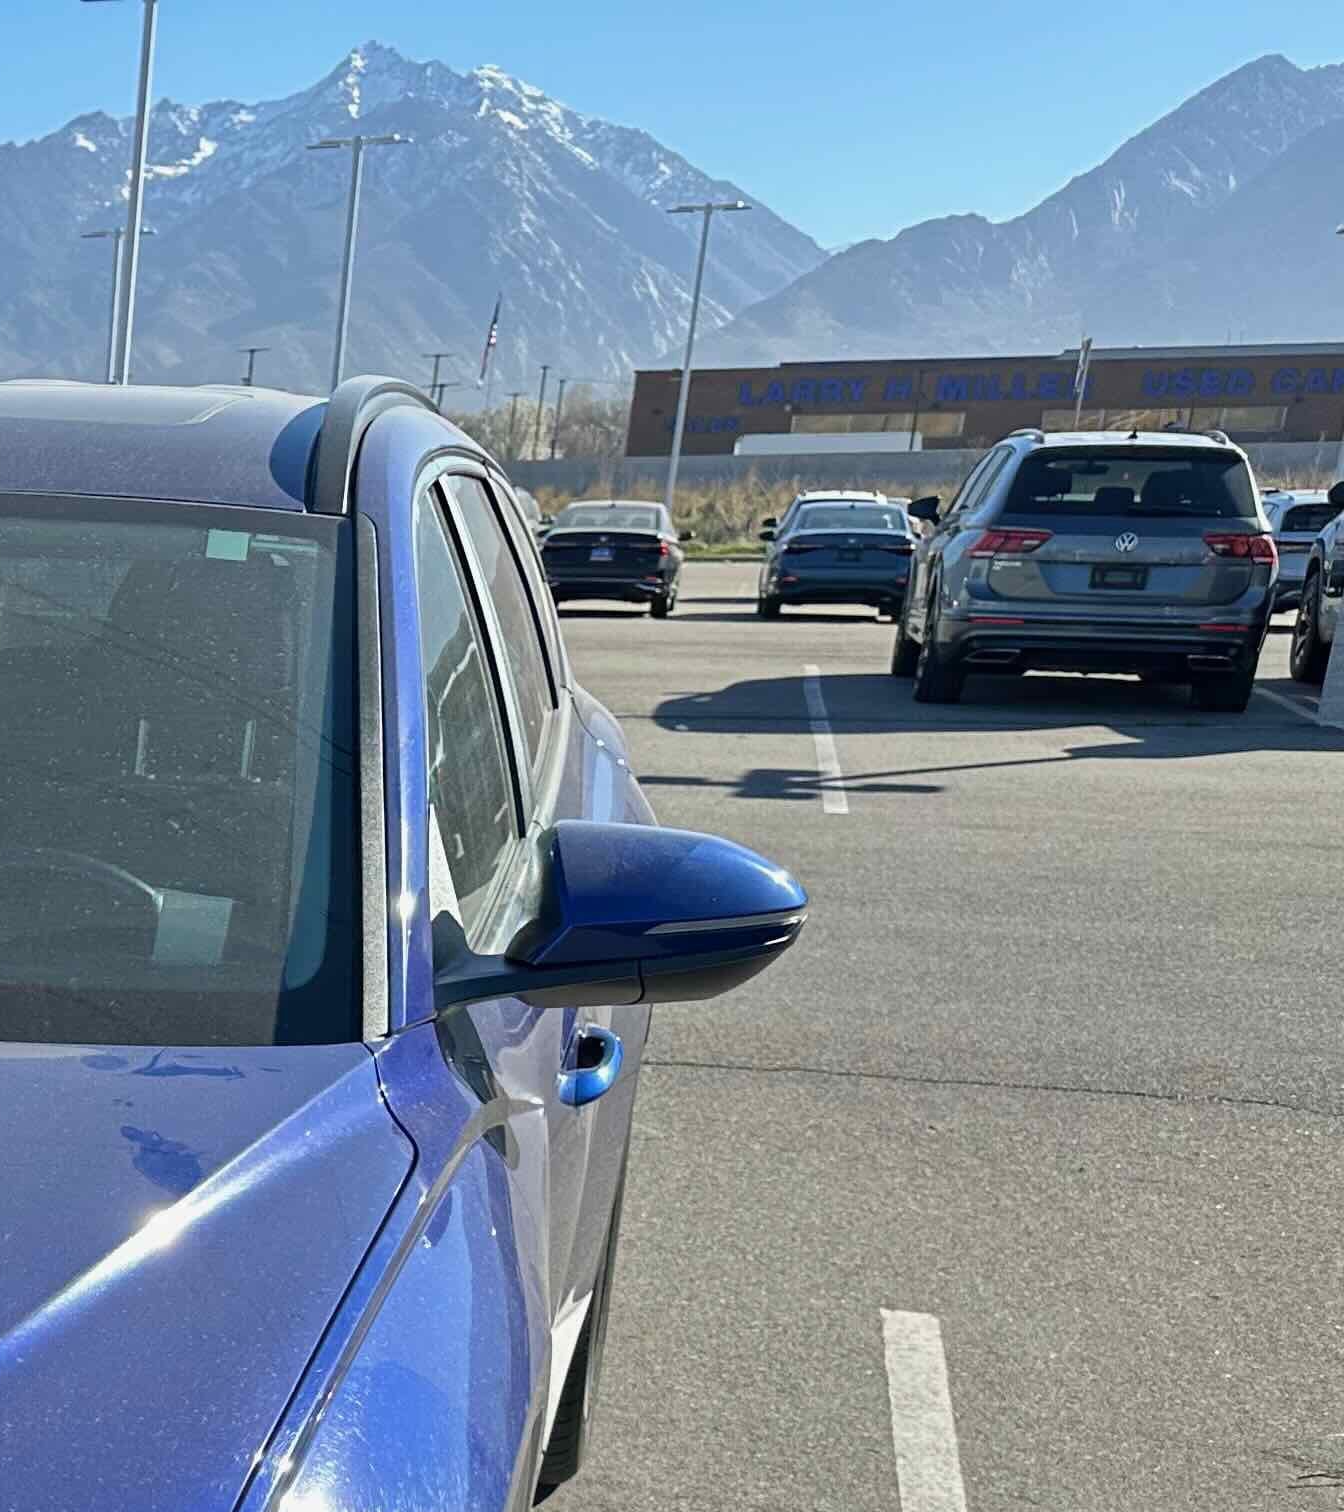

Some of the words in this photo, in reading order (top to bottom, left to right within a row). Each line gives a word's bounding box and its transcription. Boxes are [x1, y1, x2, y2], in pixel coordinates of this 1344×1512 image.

[739, 378, 865, 405] LARRY
[938, 372, 1093, 401] MILLER
[1141, 367, 1256, 399] USED
